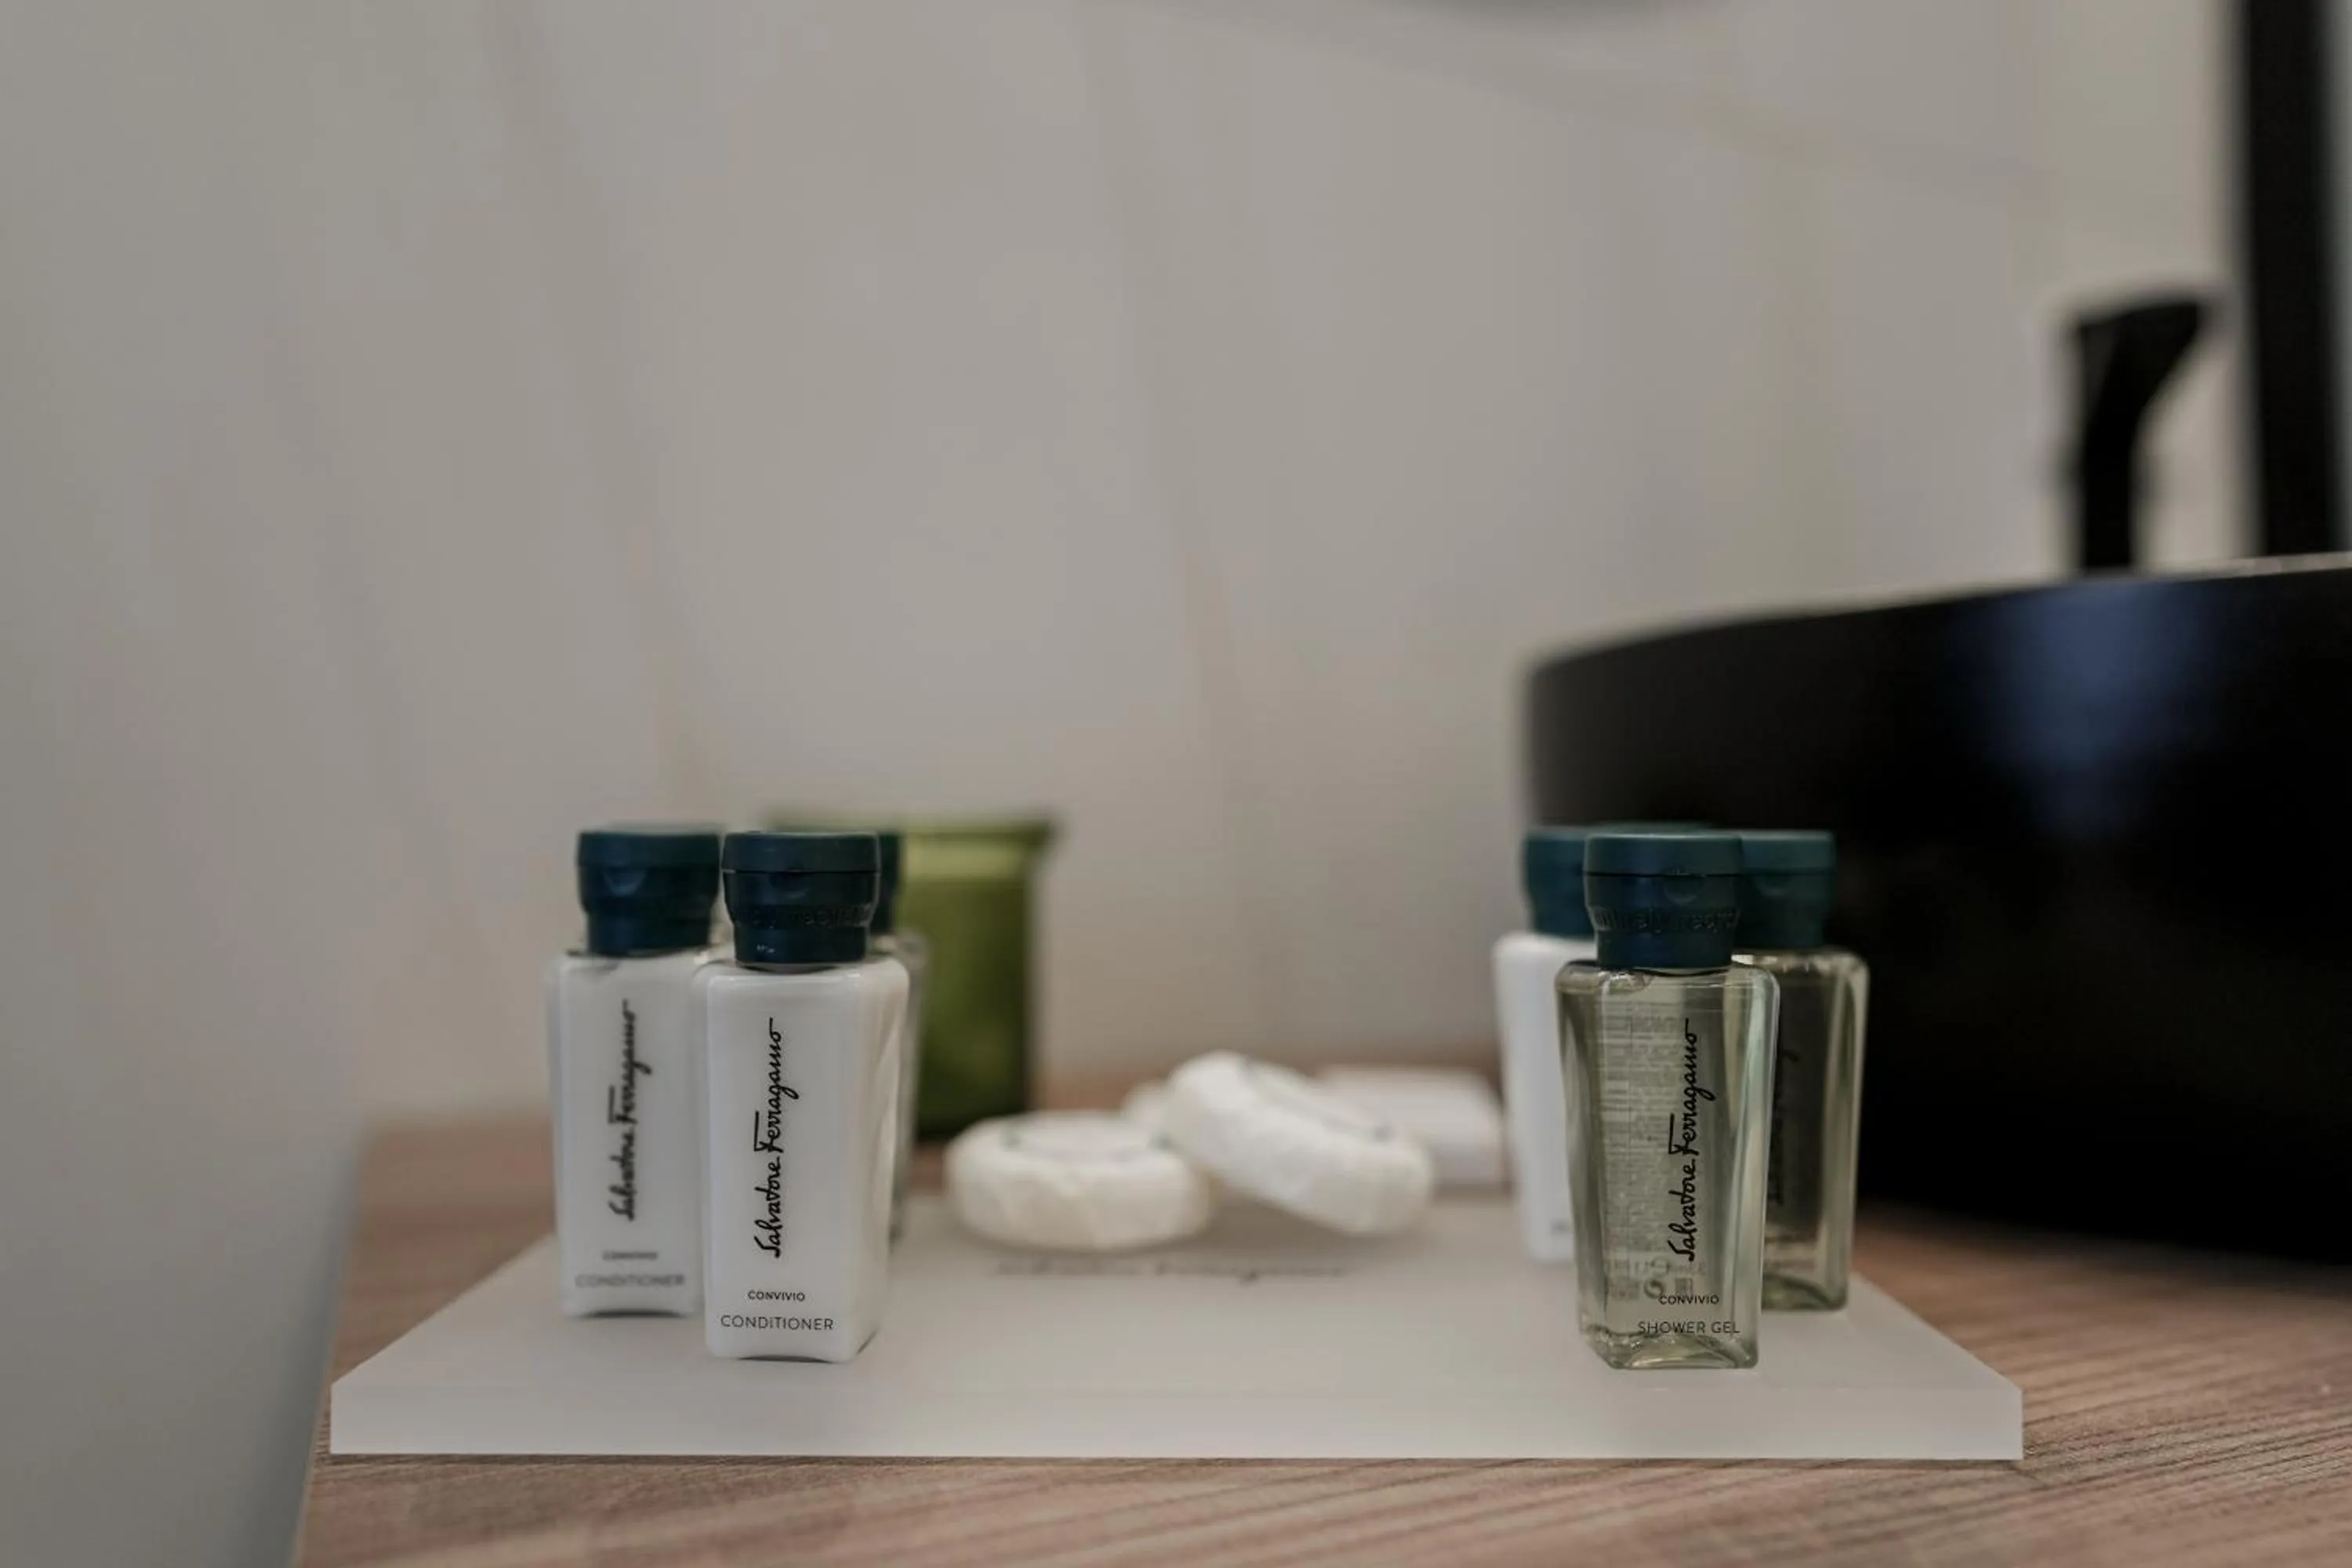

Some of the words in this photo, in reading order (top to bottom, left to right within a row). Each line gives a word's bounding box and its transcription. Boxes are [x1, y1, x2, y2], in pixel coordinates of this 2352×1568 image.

[753, 1017, 800, 1153] Ferragamo
[1667, 1018, 1717, 1156] Ferragamo
[753, 1156, 783, 1258] Salvatore
[1667, 1158, 1698, 1262] Salvatore
[720, 1314, 835, 1331] CONDITIONER
[746, 1290, 806, 1302] CONVIVIO
[1658, 1294, 1720, 1305] CONVIVIO
[1638, 1320, 1707, 1334] SHOWER
[1711, 1320, 1740, 1334] GEL
